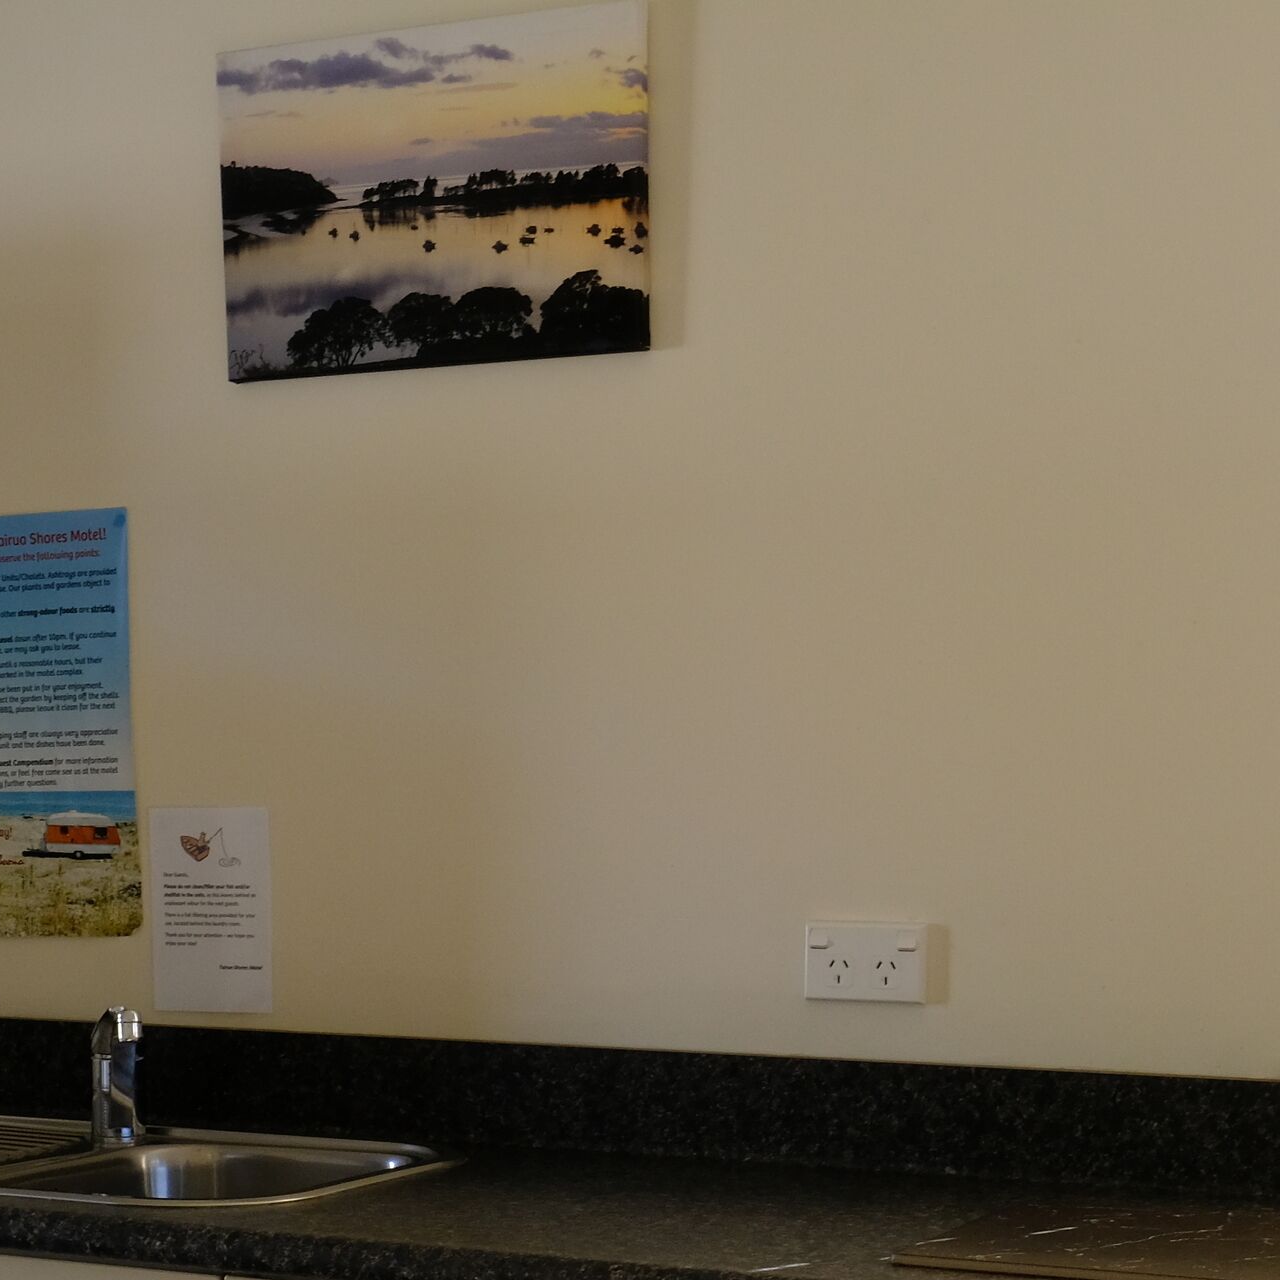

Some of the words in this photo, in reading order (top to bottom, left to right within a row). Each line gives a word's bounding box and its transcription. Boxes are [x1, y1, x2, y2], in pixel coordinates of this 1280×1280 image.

[29, 530, 67, 544] Shores
[70, 527, 106, 542] Motel!
[22, 552, 35, 561] the
[36, 549, 73, 562] following
[59, 606, 77, 615] foods
[91, 604, 115, 614] strictly
[75, 633, 87, 641] you
[40, 645, 53, 653] you
[41, 683, 50, 692] for
[77, 692, 87, 701] off
[79, 702, 88, 711] for
[54, 757, 63, 765] for
